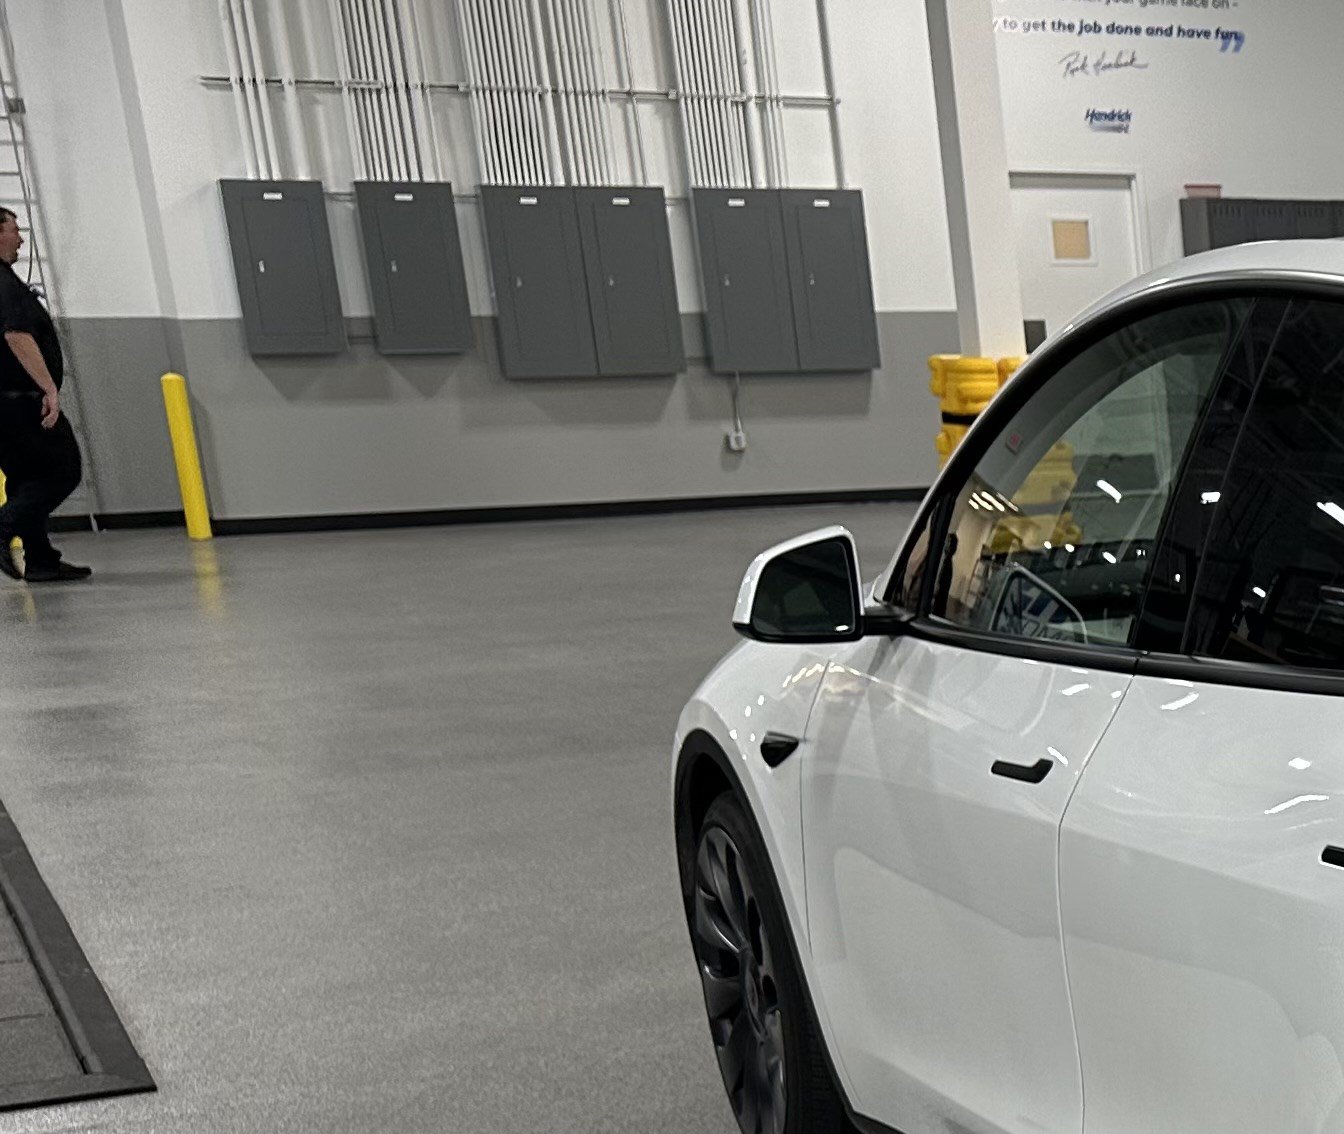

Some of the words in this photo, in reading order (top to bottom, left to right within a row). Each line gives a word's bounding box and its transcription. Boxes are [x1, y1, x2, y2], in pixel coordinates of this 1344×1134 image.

[1003, 19, 1018, 31] to
[1023, 20, 1046, 33] get
[1051, 19, 1075, 33] the
[1078, 19, 1102, 36] job
[1106, 22, 1142, 36] done
[1146, 24, 1173, 38] and
[1177, 25, 1211, 40] have
